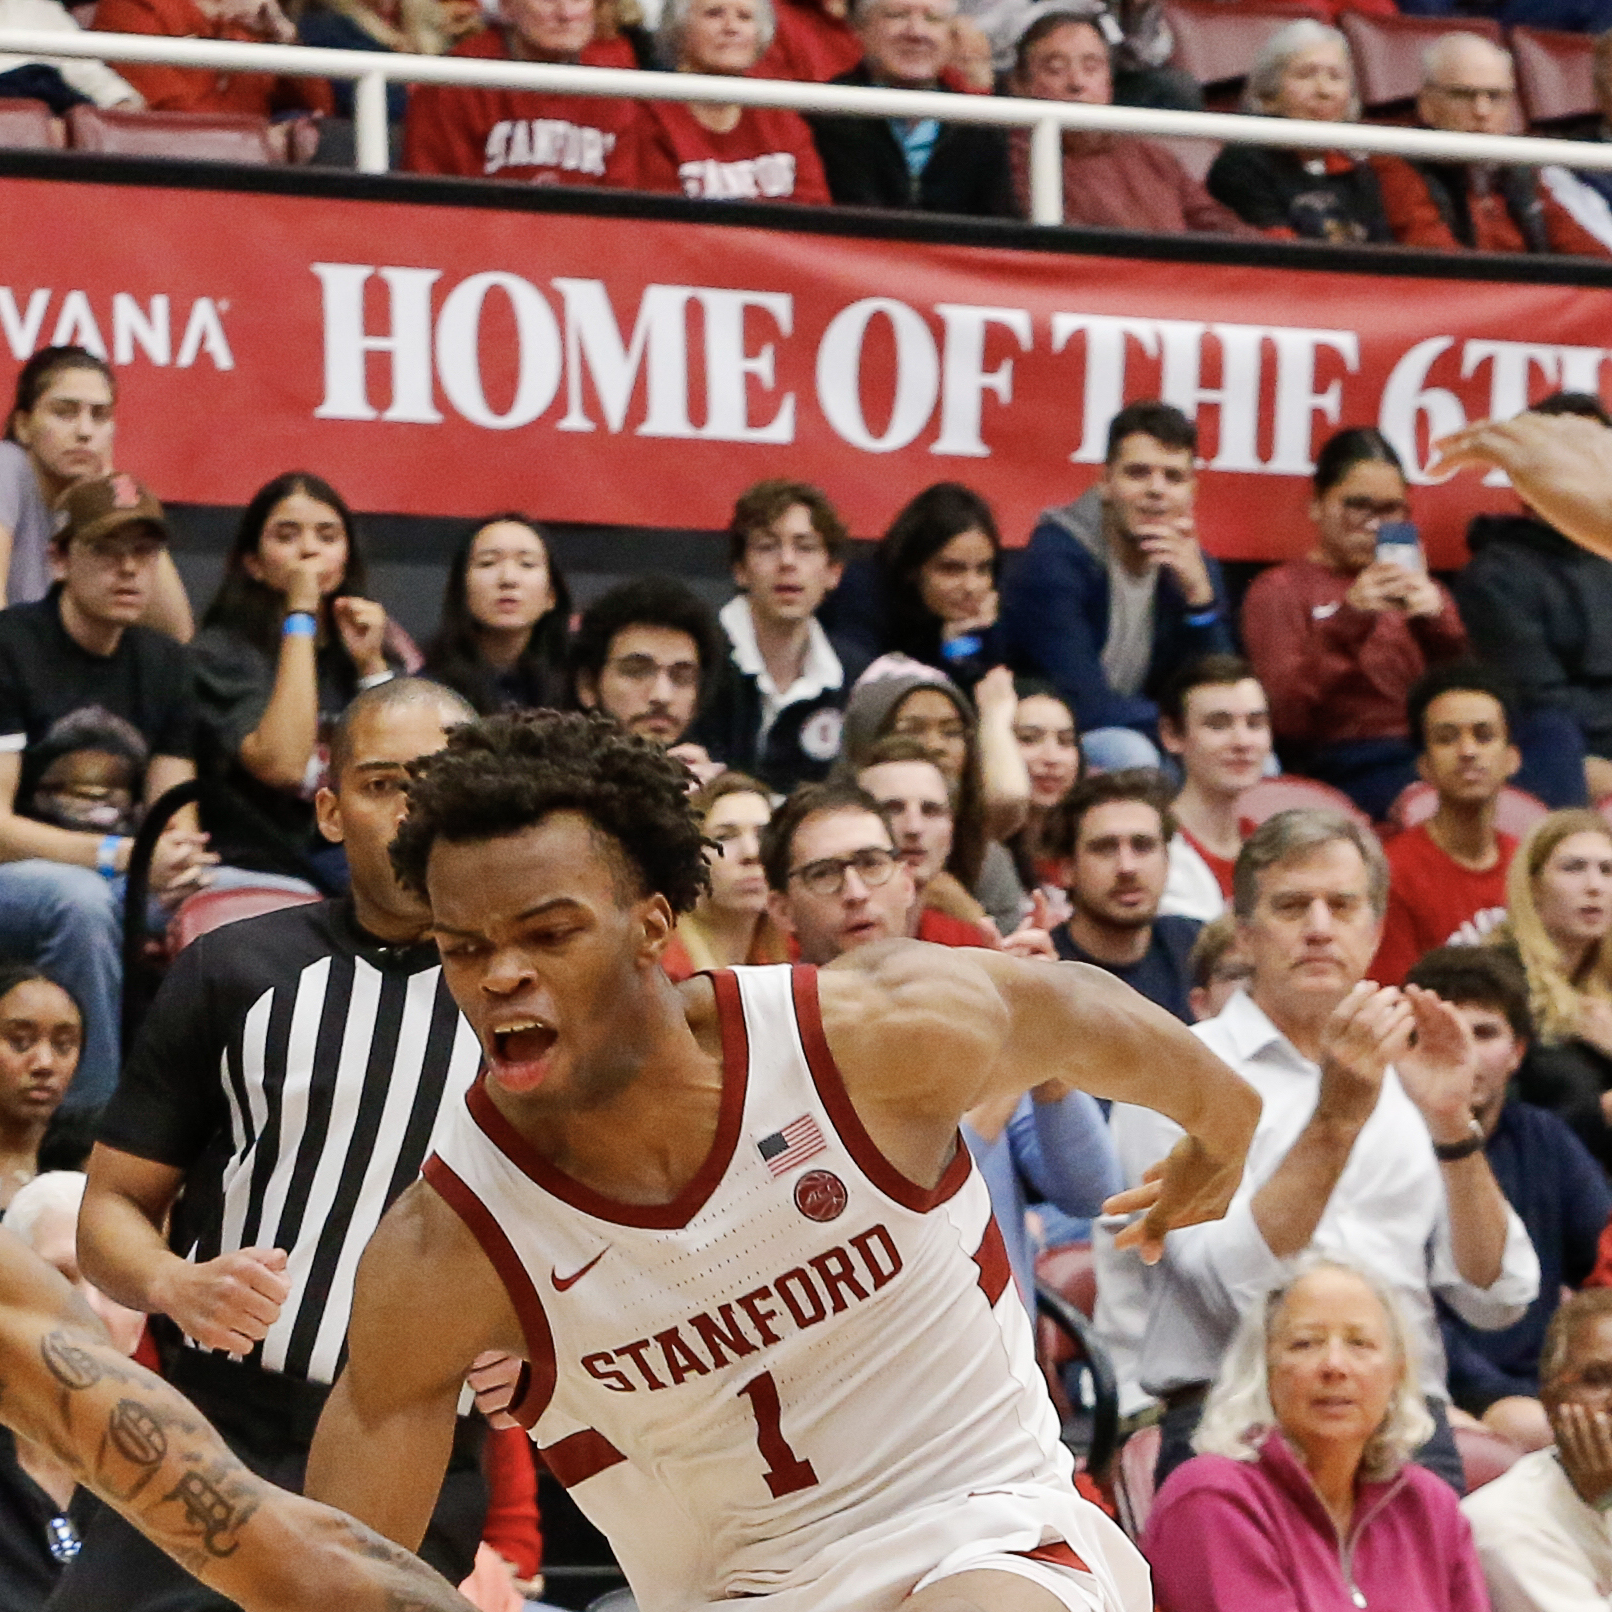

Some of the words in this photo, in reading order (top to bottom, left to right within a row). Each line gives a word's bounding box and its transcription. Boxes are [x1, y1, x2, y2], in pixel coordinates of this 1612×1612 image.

[310, 261, 796, 444] HOME
[815, 296, 1034, 458] OF
[1050, 311, 1361, 477] THE
[580, 1223, 905, 1393] STANFORD
[736, 1369, 821, 1500] 1
